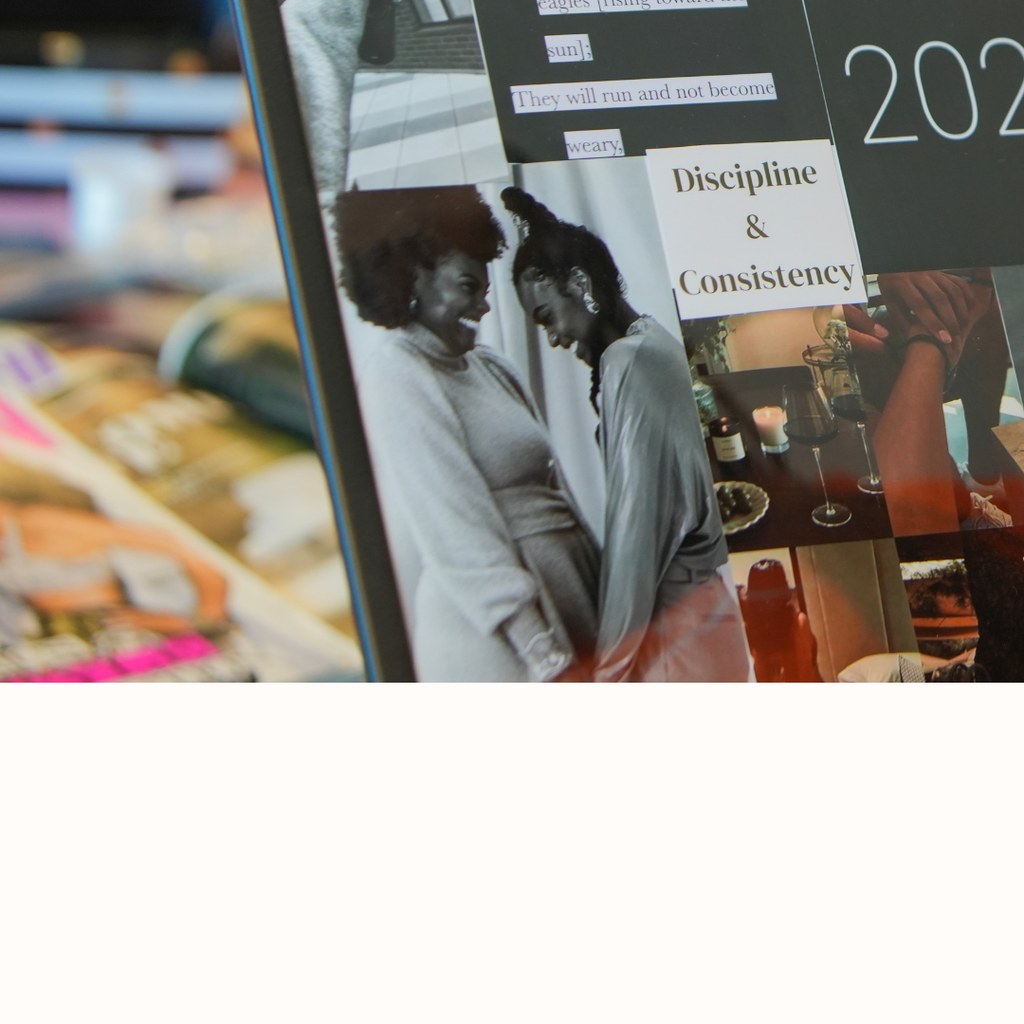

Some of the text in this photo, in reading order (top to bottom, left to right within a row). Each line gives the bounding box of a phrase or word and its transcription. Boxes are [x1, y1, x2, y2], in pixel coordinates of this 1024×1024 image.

[547, 39, 593, 61] sun];
[511, 80, 776, 112] They will run and not become
[566, 139, 624, 157] weary,
[672, 160, 818, 197] Discipline
[745, 213, 770, 240] &
[678, 262, 856, 296] Consistency
